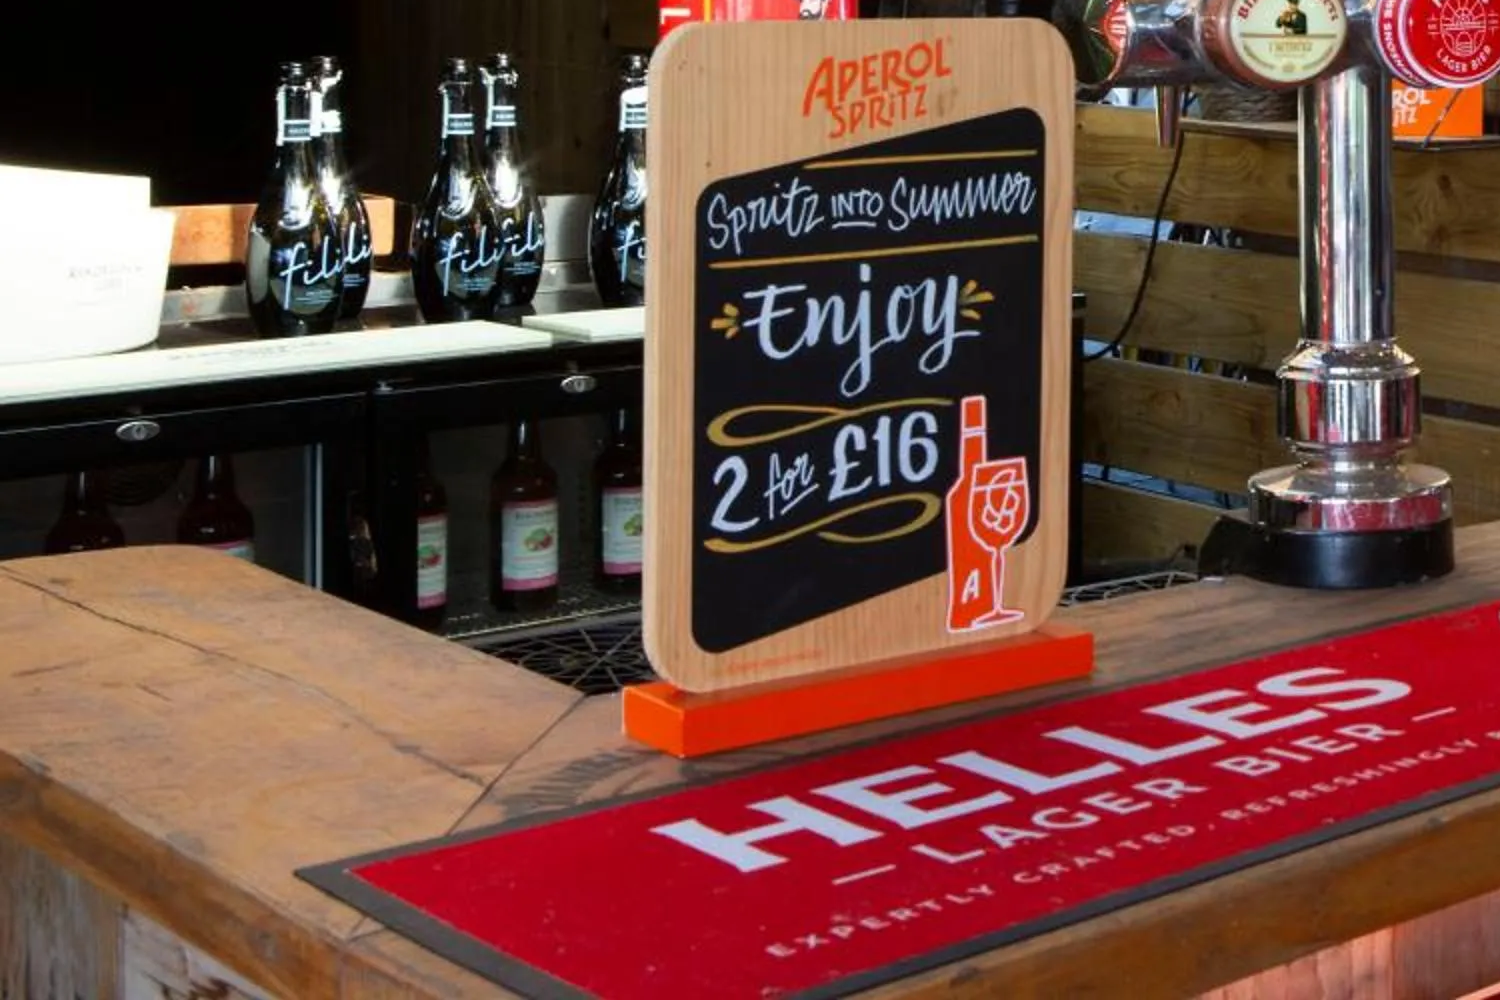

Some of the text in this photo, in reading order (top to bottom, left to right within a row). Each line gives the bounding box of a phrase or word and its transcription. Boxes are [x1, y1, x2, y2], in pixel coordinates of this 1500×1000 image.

[802, 38, 953, 117] APEROL
[1392, 86, 1432, 109] ROL
[1436, 43, 1492, 73] LAGER BIER
[828, 85, 928, 139] SPRITZ
[707, 171, 1037, 255] Spritz INTO Summer
[742, 263, 982, 397] Enjoy
[710, 411, 939, 532] 2 for £16
[961, 569, 981, 605] A
[651, 667, 1412, 875] HELLES
[910, 722, 1407, 864] LAGER BIER
[765, 883, 995, 958] EXPERTLY
[1218, 737, 1480, 822] REFRESHINGLY
